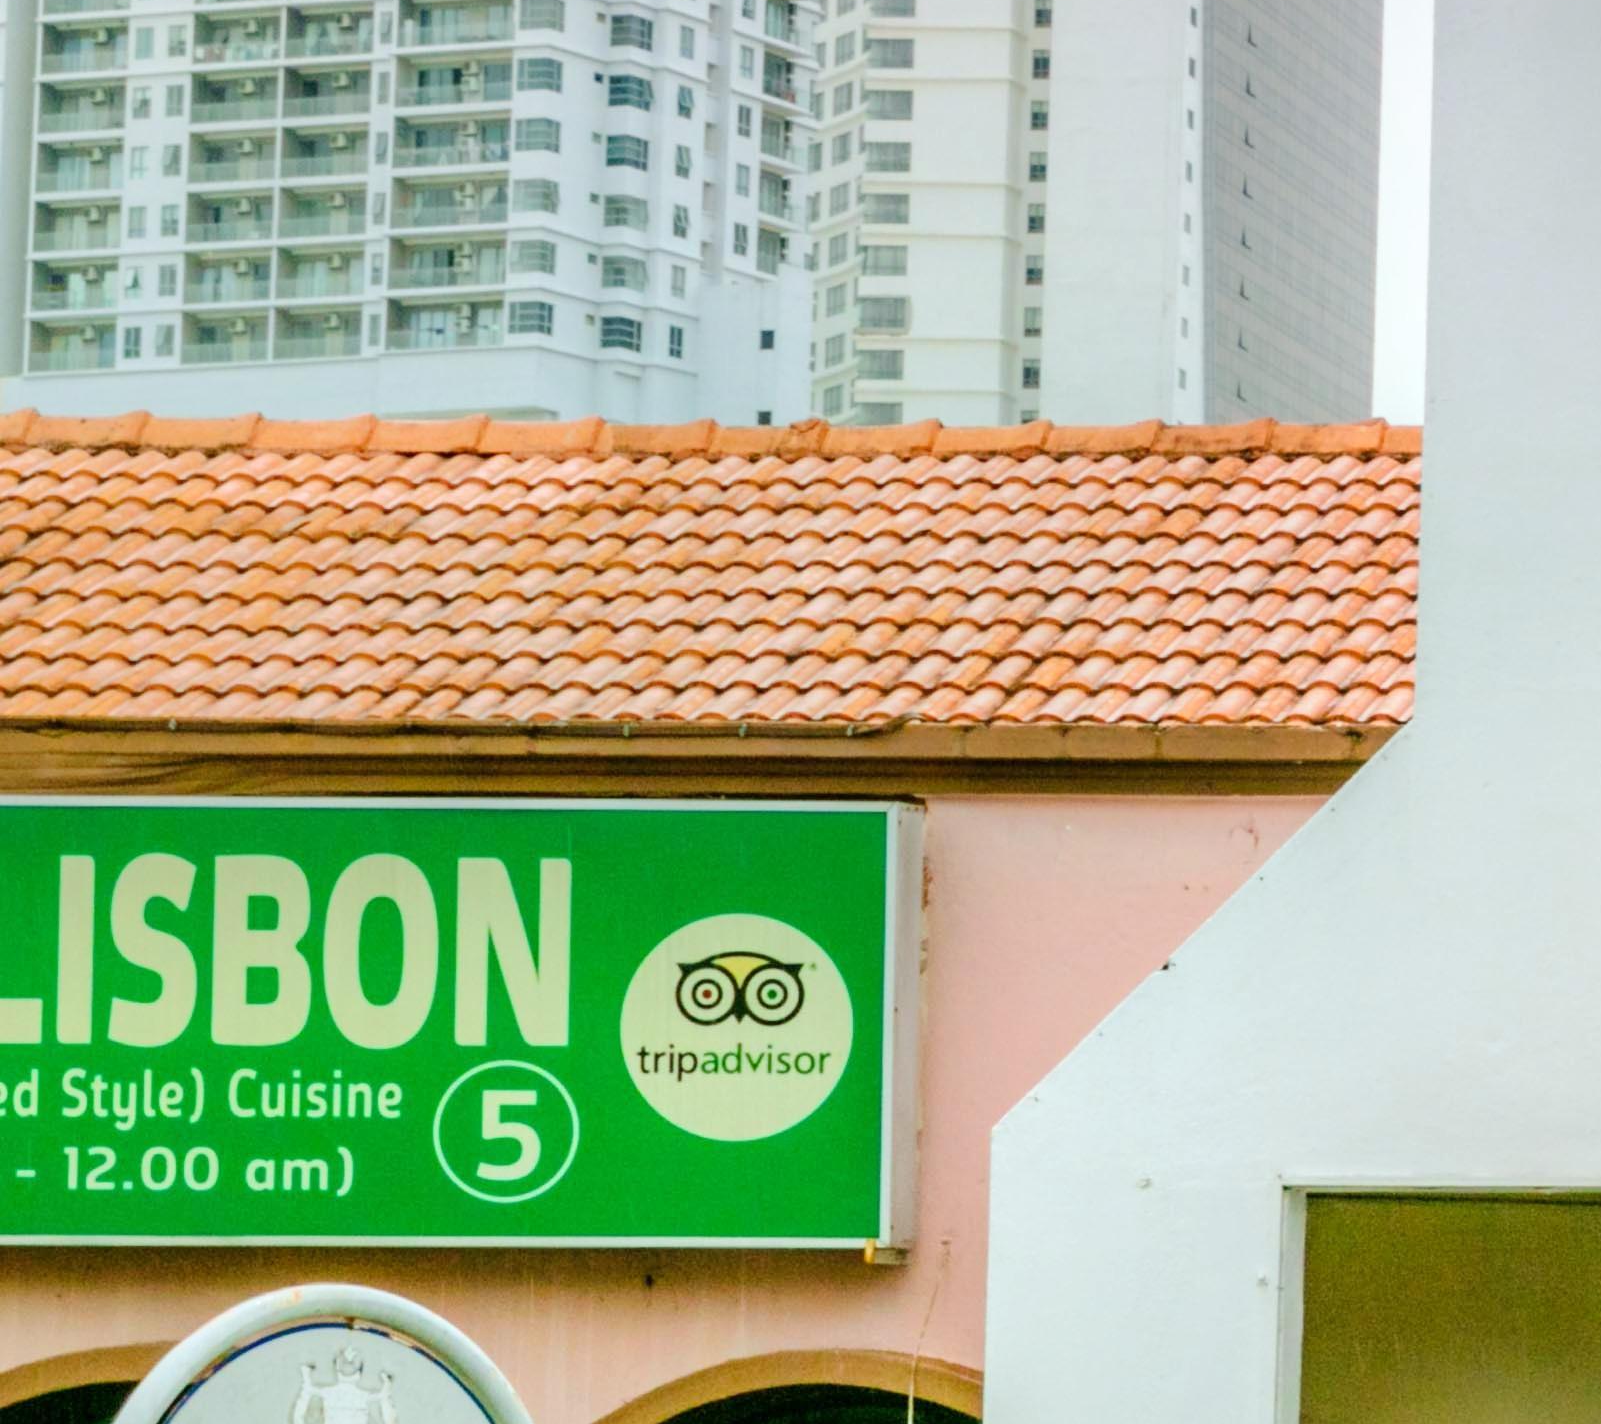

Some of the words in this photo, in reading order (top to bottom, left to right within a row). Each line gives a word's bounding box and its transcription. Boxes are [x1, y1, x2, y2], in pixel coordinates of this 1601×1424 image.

[636, 1042, 832, 1083] tripadvisor
[61, 1067, 205, 1131] Style)
[228, 1067, 403, 1119] Cuisine
[476, 1089, 542, 1182] 5
[63, 1145, 220, 1191] 12.00
[245, 1146, 354, 1198] am)
